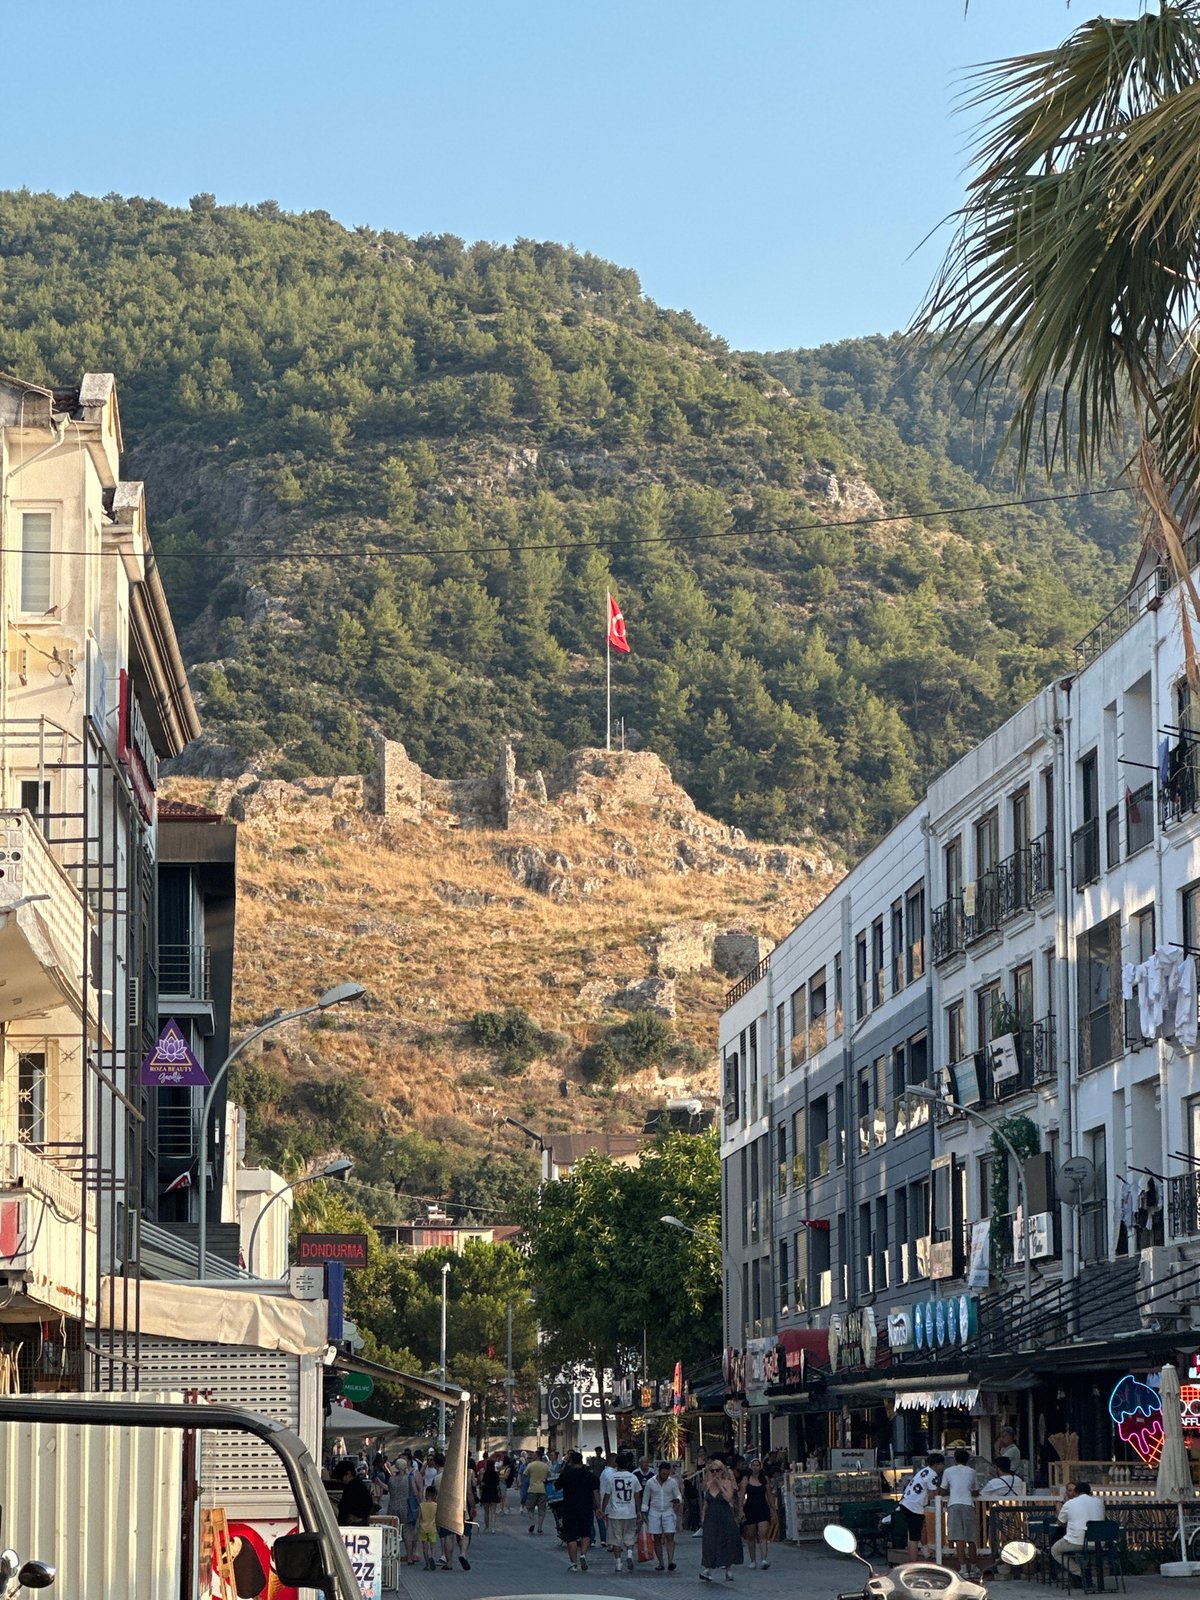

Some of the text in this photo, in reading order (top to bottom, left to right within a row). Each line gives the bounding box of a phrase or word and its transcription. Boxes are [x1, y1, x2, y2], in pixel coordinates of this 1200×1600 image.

[302, 1242, 365, 1258] DONDURMA
[344, 1535, 370, 1554] HR
[352, 1562, 375, 1581] ZZ
